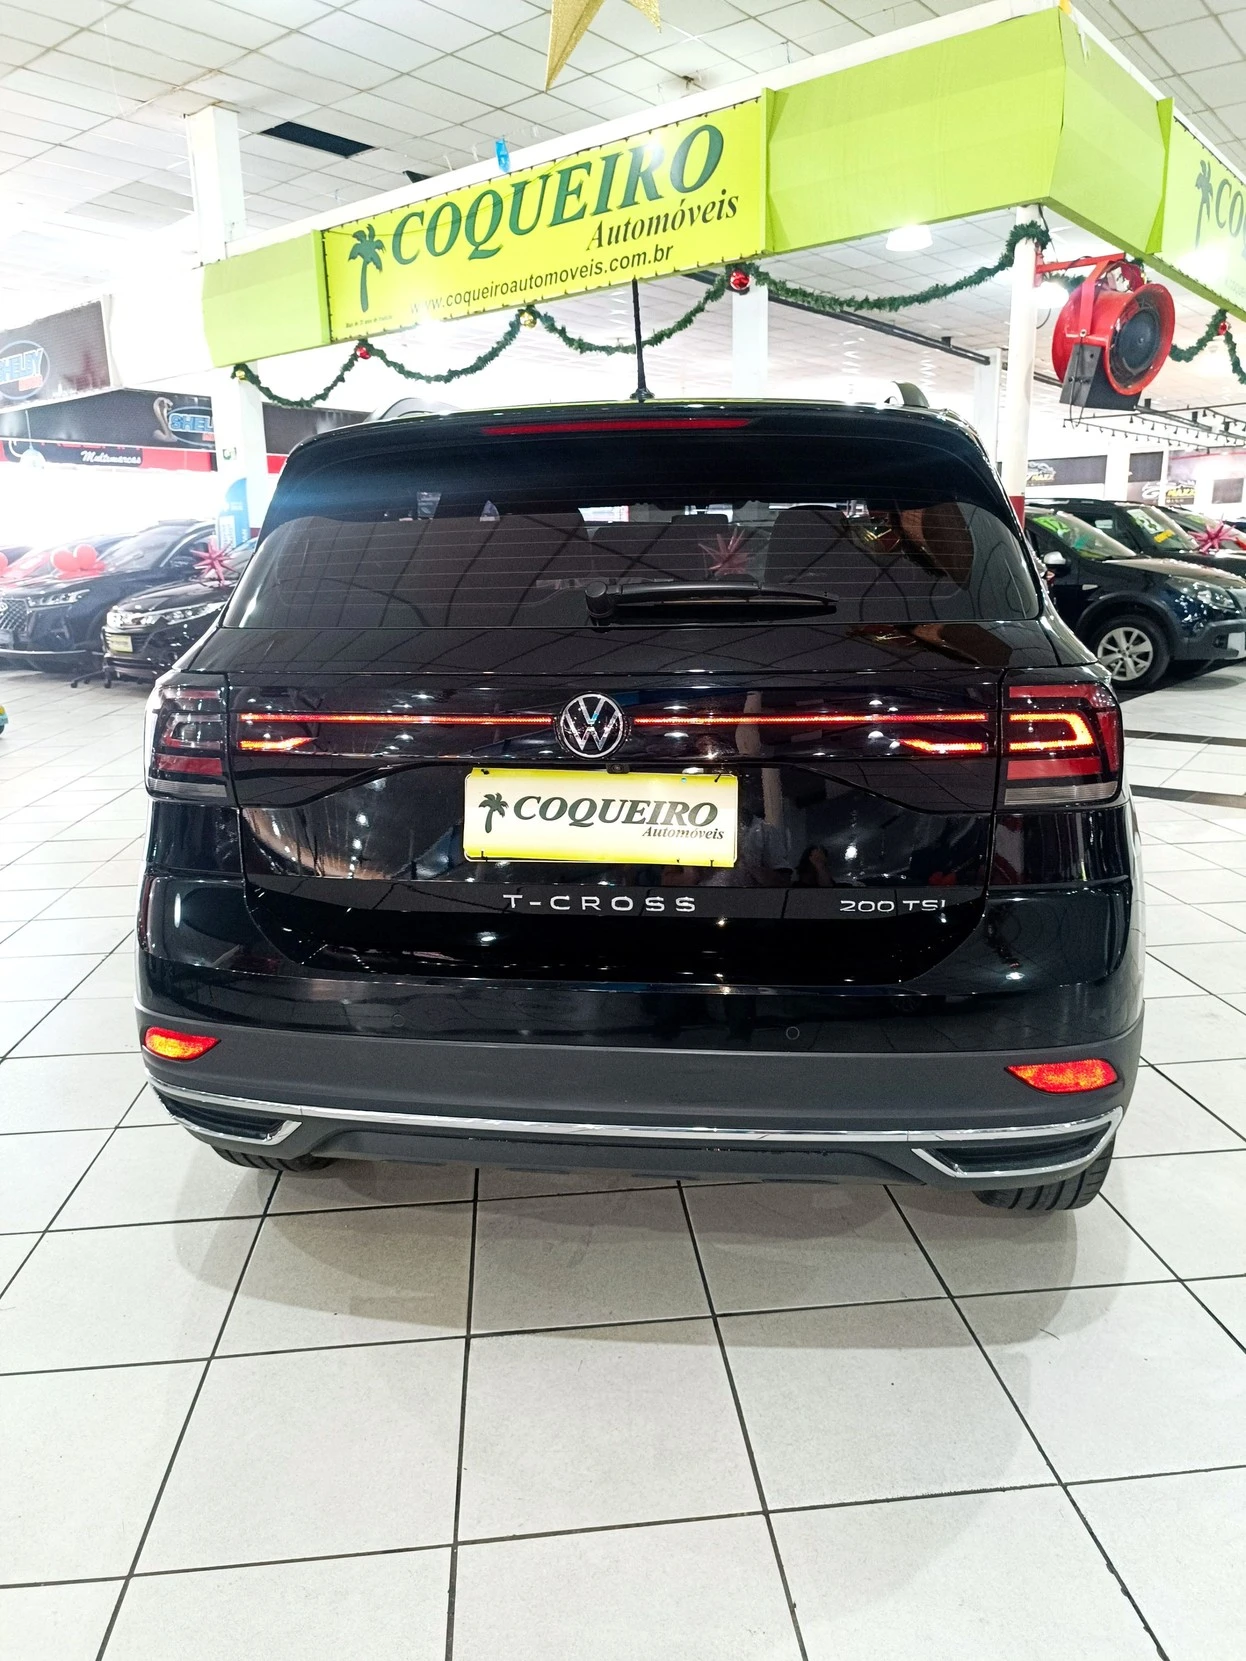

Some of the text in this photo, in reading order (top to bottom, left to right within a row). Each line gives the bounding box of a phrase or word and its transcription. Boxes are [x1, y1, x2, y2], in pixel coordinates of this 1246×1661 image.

[392, 124, 724, 265] COQUEIRO
[586, 189, 739, 251] Automóveis
[513, 795, 719, 828] COQUEIRO
[642, 825, 725, 840] Automóveis
[503, 894, 696, 912] T-CROSS
[839, 899, 946, 912] 200 TSI
